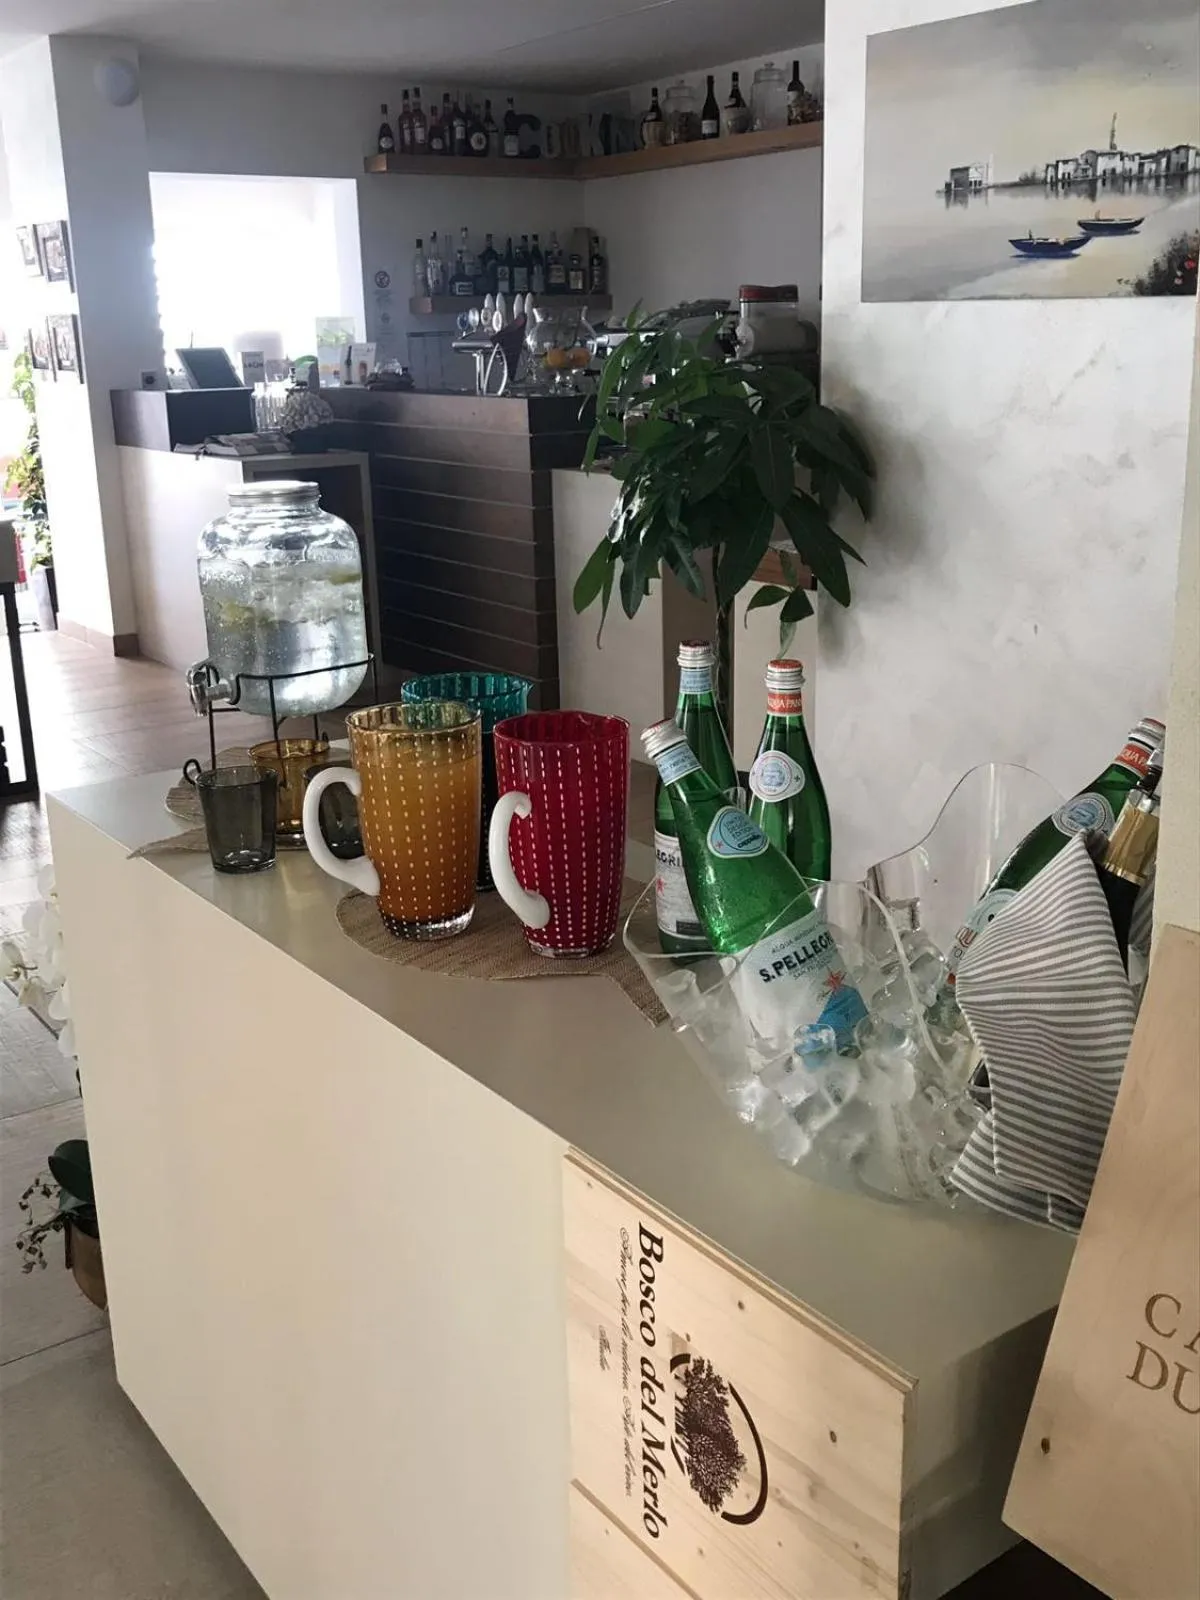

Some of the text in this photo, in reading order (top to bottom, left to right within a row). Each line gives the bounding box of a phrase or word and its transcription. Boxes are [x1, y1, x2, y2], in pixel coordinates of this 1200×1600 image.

[638, 1220, 669, 1540] Bosco del Merlo
